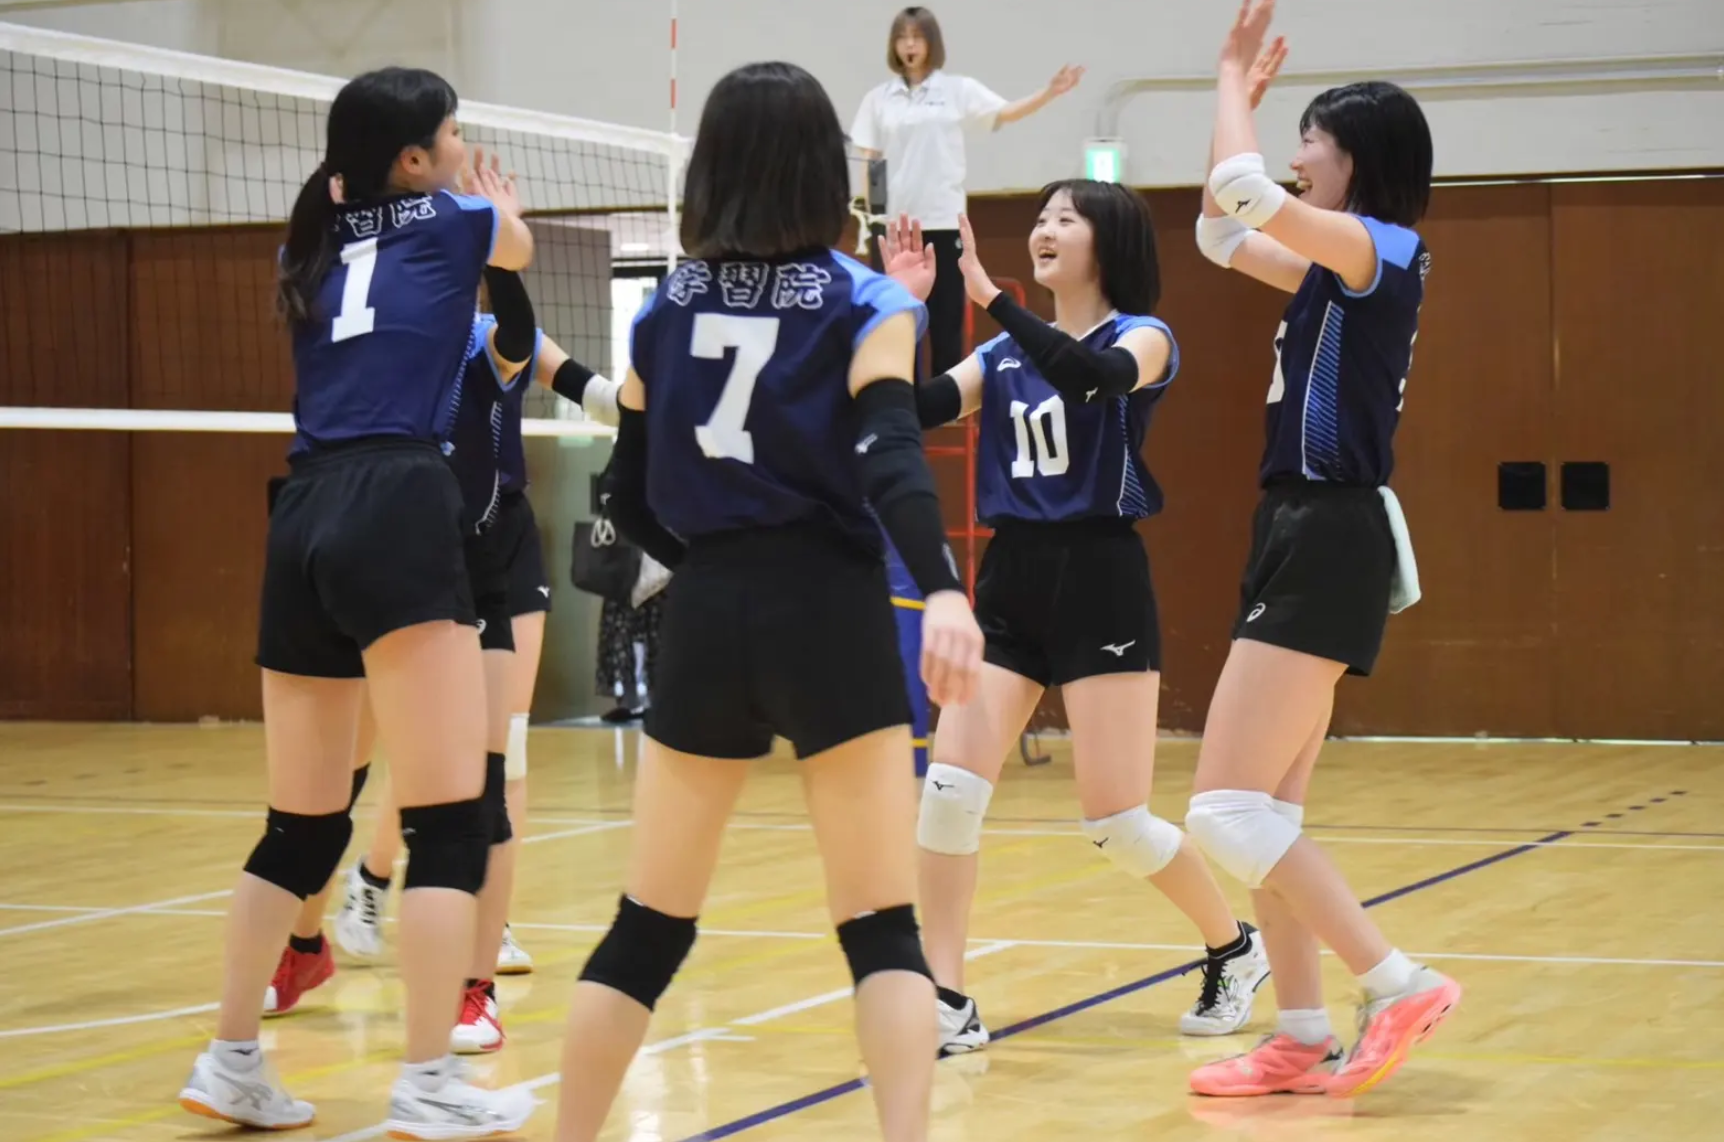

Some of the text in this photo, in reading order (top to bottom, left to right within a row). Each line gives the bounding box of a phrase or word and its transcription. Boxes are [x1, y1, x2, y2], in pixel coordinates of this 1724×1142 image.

[334, 196, 437, 238] 習院
[331, 237, 378, 343] 1
[667, 260, 831, 309] 学習院
[690, 312, 780, 464] 7
[1010, 394, 1069, 478] 10
